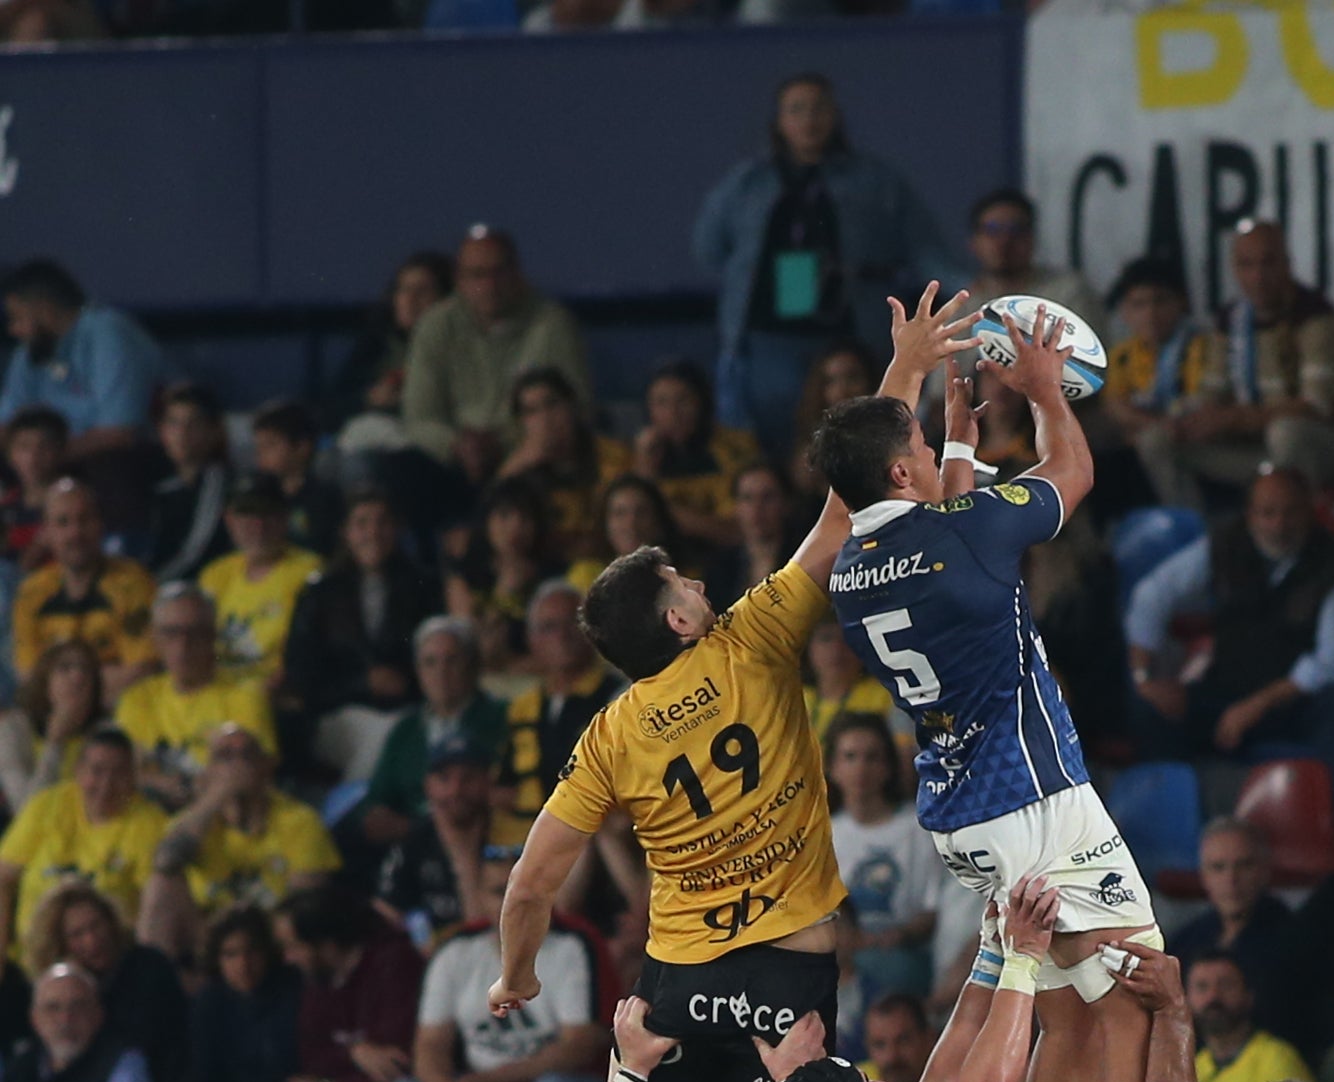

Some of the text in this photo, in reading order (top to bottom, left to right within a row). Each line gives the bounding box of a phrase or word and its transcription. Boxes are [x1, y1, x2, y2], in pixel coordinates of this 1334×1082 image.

[829, 551, 930, 593] meléndez
[862, 608, 941, 707] 5
[648, 677, 721, 732] itesal
[661, 703, 721, 745] ventanas
[661, 723, 761, 821] 19
